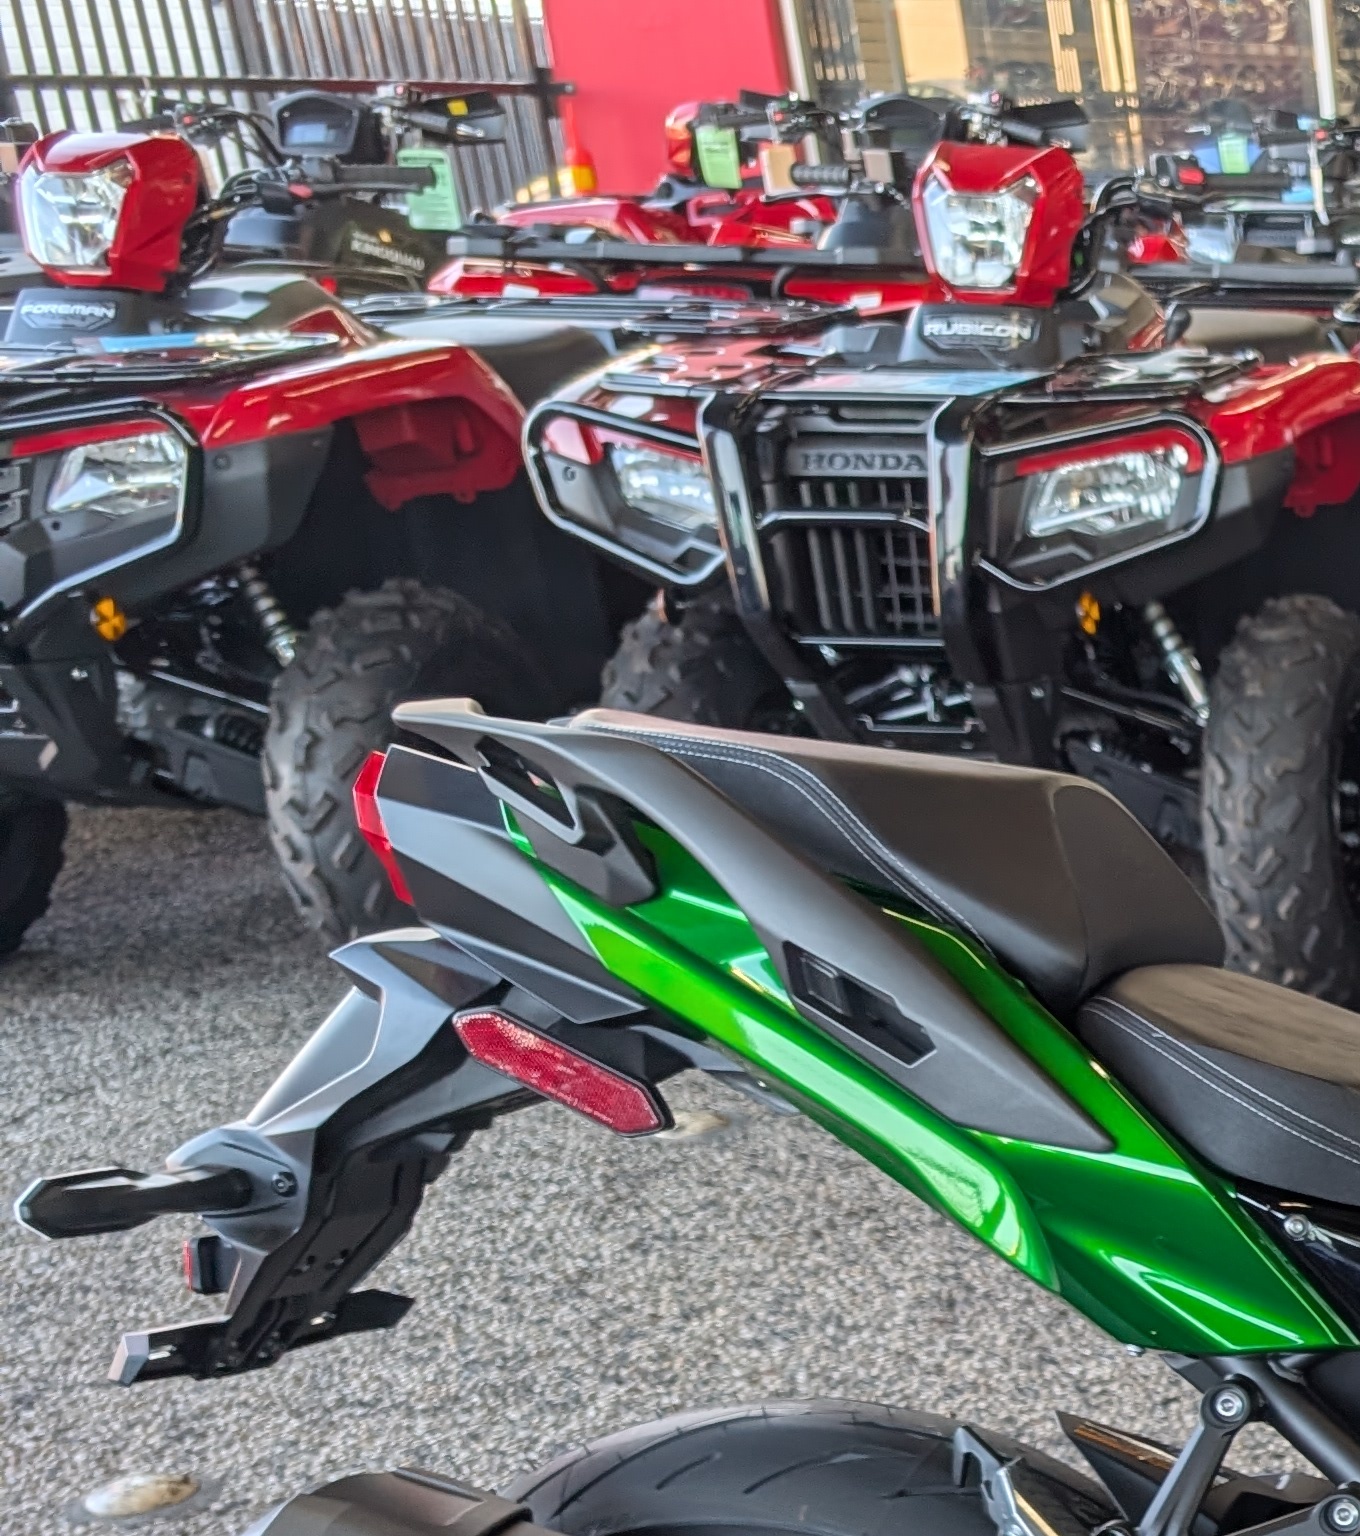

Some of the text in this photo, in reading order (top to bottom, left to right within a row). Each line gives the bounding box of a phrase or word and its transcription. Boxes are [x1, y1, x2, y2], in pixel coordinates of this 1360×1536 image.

[20, 303, 116, 319] FOREMAN
[923, 323, 1032, 341] RUBICON
[802, 452, 928, 472] HONDA
